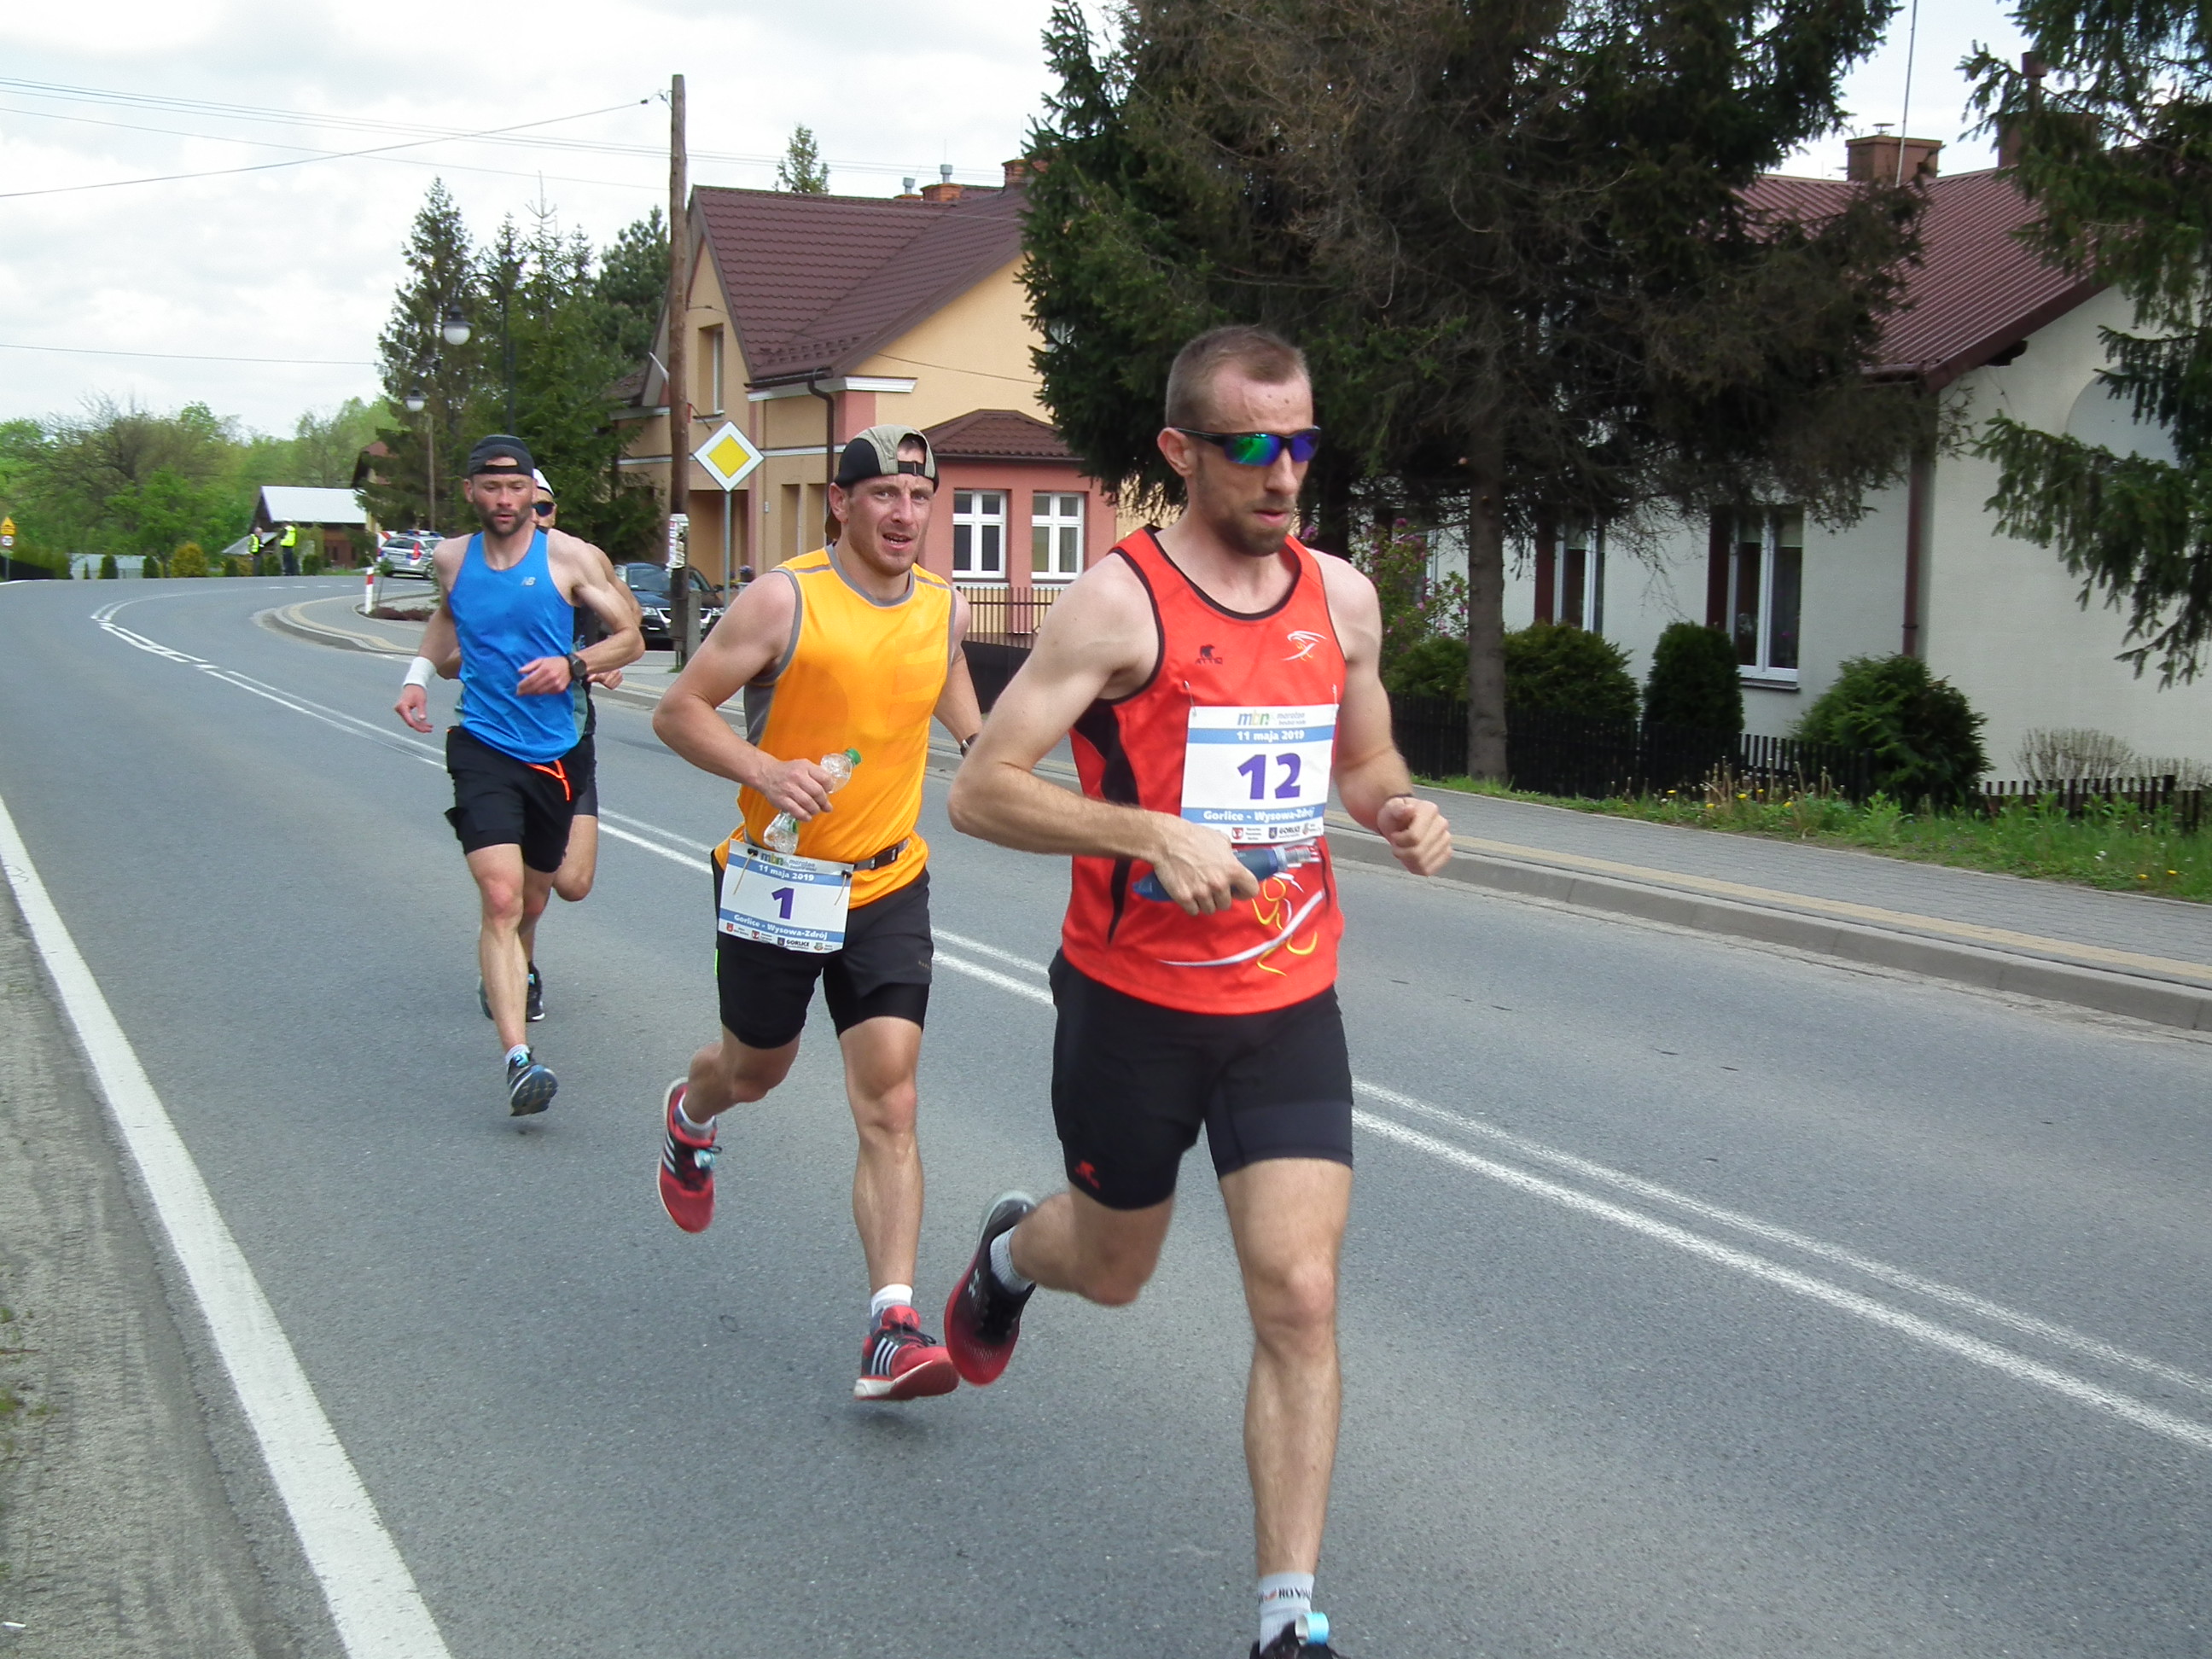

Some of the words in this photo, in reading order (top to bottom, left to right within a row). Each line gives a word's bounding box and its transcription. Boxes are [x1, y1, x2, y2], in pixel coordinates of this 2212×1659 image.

[1237, 731, 1249, 741] 11
[1253, 730, 1279, 742] maja
[1281, 730, 1305, 740] 2019
[1237, 753, 1301, 800] 12
[1203, 810, 1243, 821] Gorlice
[759, 864, 769, 872] 11
[770, 868, 789, 879] maja
[792, 872, 814, 882] 2019
[771, 887, 795, 920] 1
[734, 914, 760, 927] Gorlice
[767, 923, 828, 940] Wysowa-Zdrój
[787, 939, 810, 947] GORLICE
